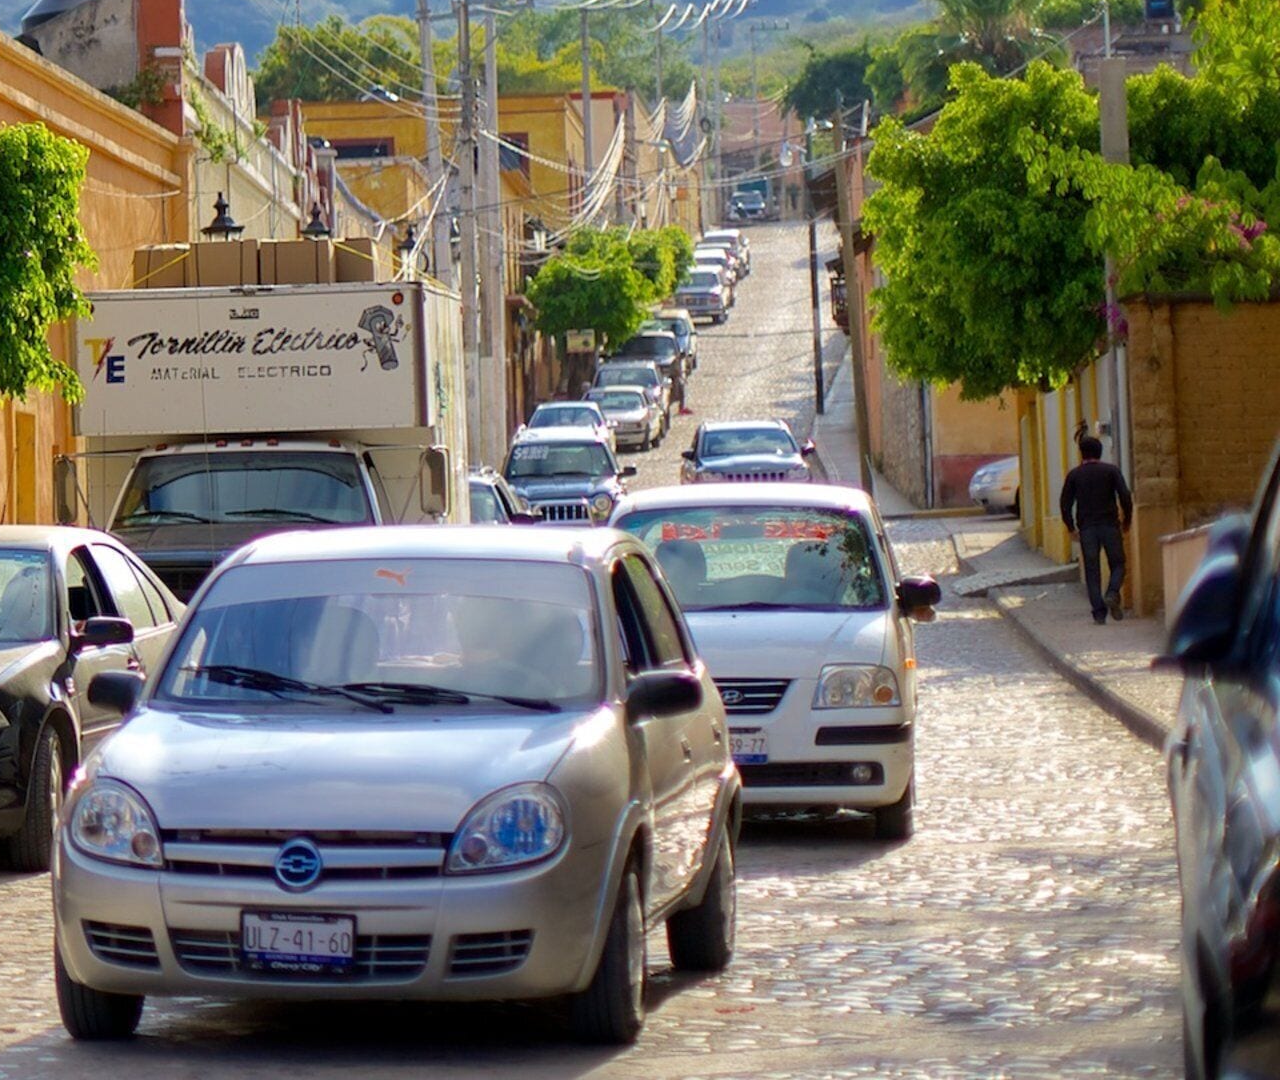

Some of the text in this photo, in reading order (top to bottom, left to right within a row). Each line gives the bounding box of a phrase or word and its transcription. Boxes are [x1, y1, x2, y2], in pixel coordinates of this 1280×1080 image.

[150, 365, 332, 380] MATERIAL ELECTRICO
[246, 926, 350, 953] ULZ-41-60
